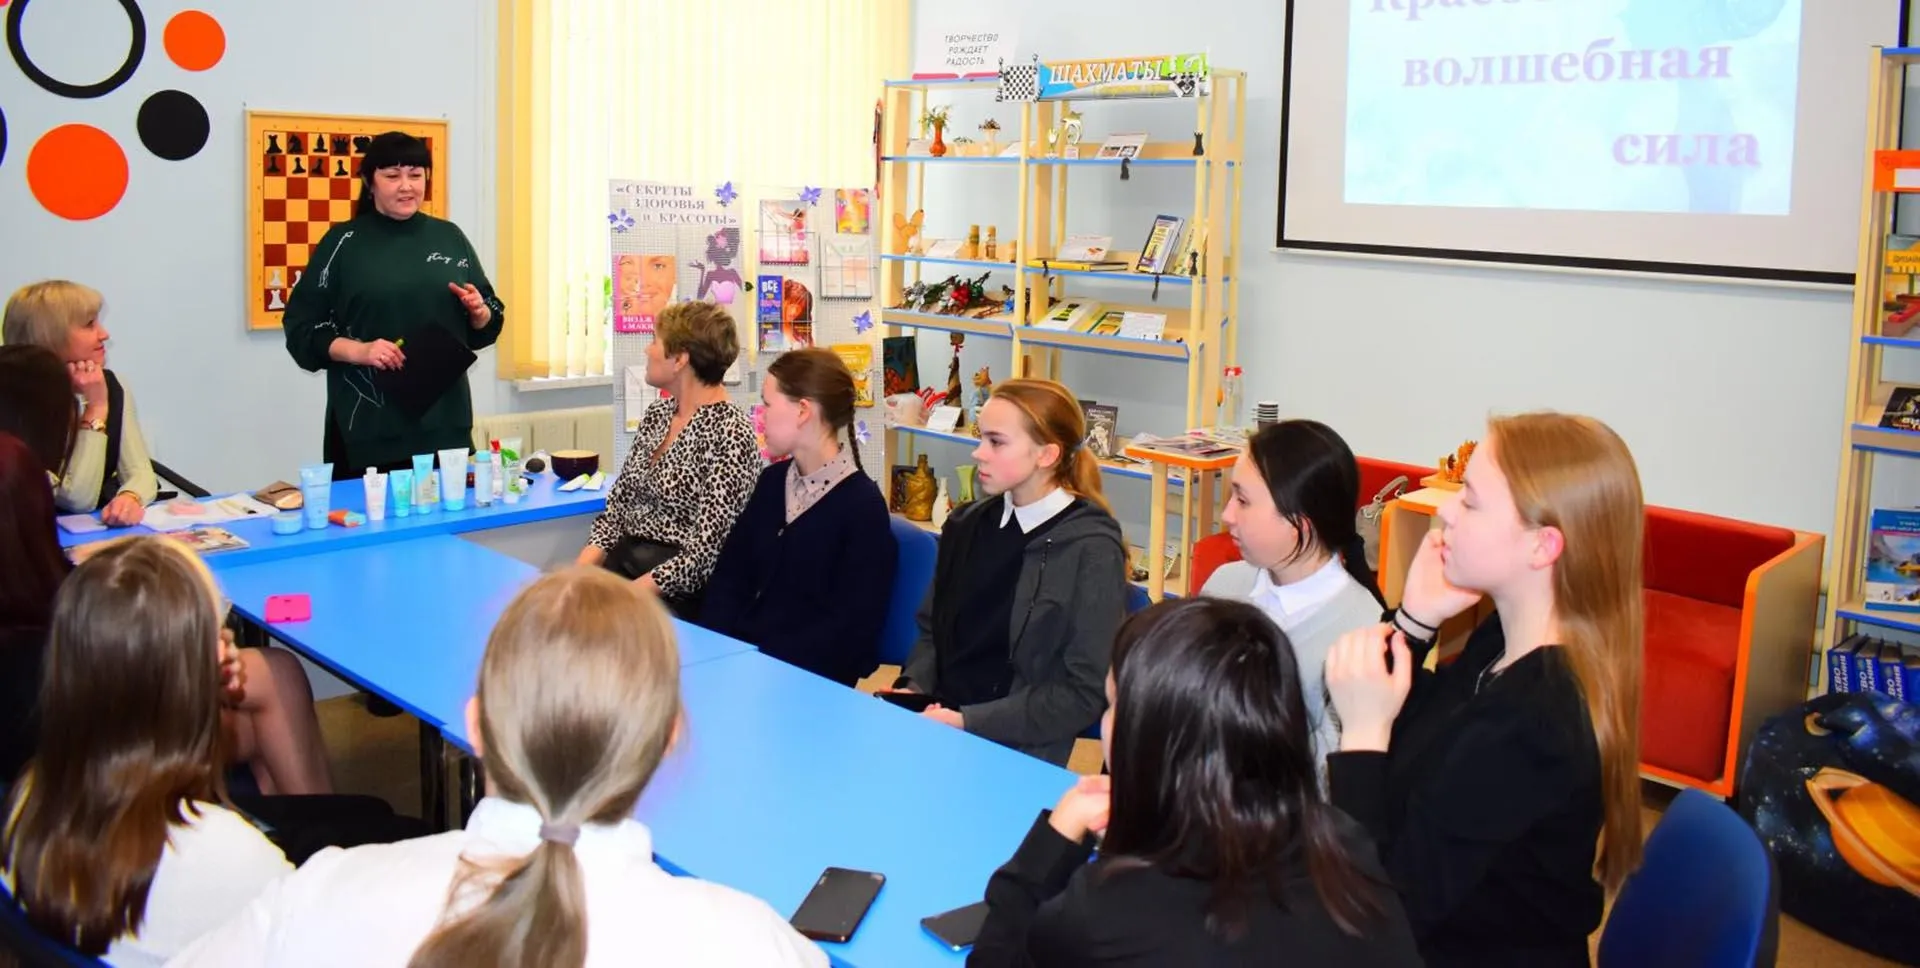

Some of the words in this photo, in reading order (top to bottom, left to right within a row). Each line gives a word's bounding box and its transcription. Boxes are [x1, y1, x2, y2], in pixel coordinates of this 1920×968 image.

[945, 33, 999, 42] ТВОРЧЕСТВО
[949, 45, 989, 54] РОЖДАЕТ
[946, 56, 985, 66] РАДОСТЬ
[1402, 38, 1734, 87] волшебная
[1050, 60, 1164, 85] ШАХМАТЫ
[1612, 133, 1762, 168] сила
[635, 198, 705, 210] ЗДОРОВЬЯ
